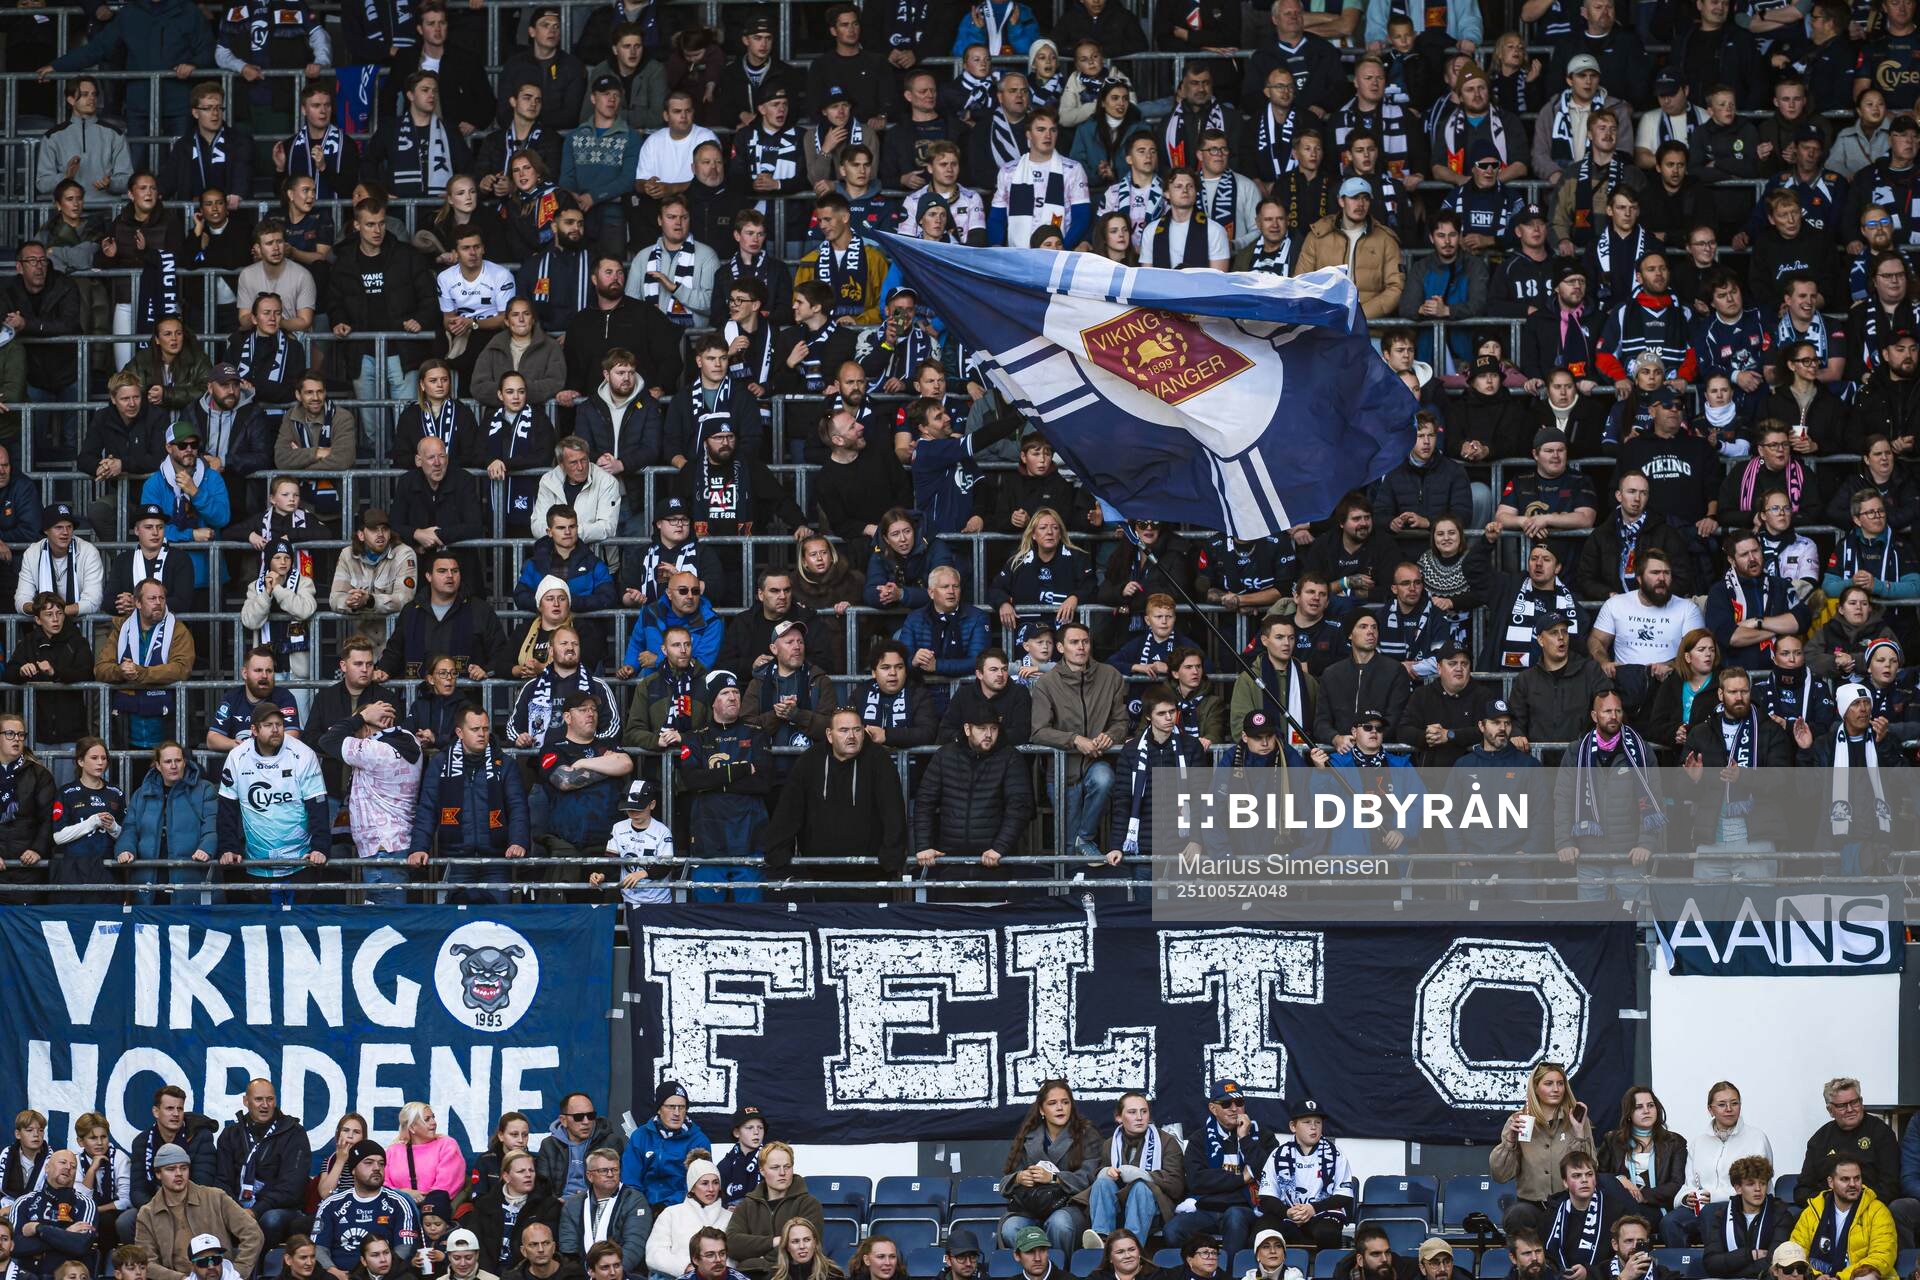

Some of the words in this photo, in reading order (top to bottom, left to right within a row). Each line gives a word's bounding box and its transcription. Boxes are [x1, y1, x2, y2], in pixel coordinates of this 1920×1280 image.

[1092, 312, 1162, 352] VIKING
[1147, 358, 1174, 376] 1899
[1641, 458, 1692, 477] VIKING
[1628, 615, 1657, 624] VIKING
[255, 790, 293, 807] Lyse
[1669, 896, 1887, 965] AANS
[41, 920, 421, 1030] VIKING
[474, 1012, 503, 1028] 1993
[640, 922, 1326, 1114] FELT
[1412, 936, 1592, 1111] O
